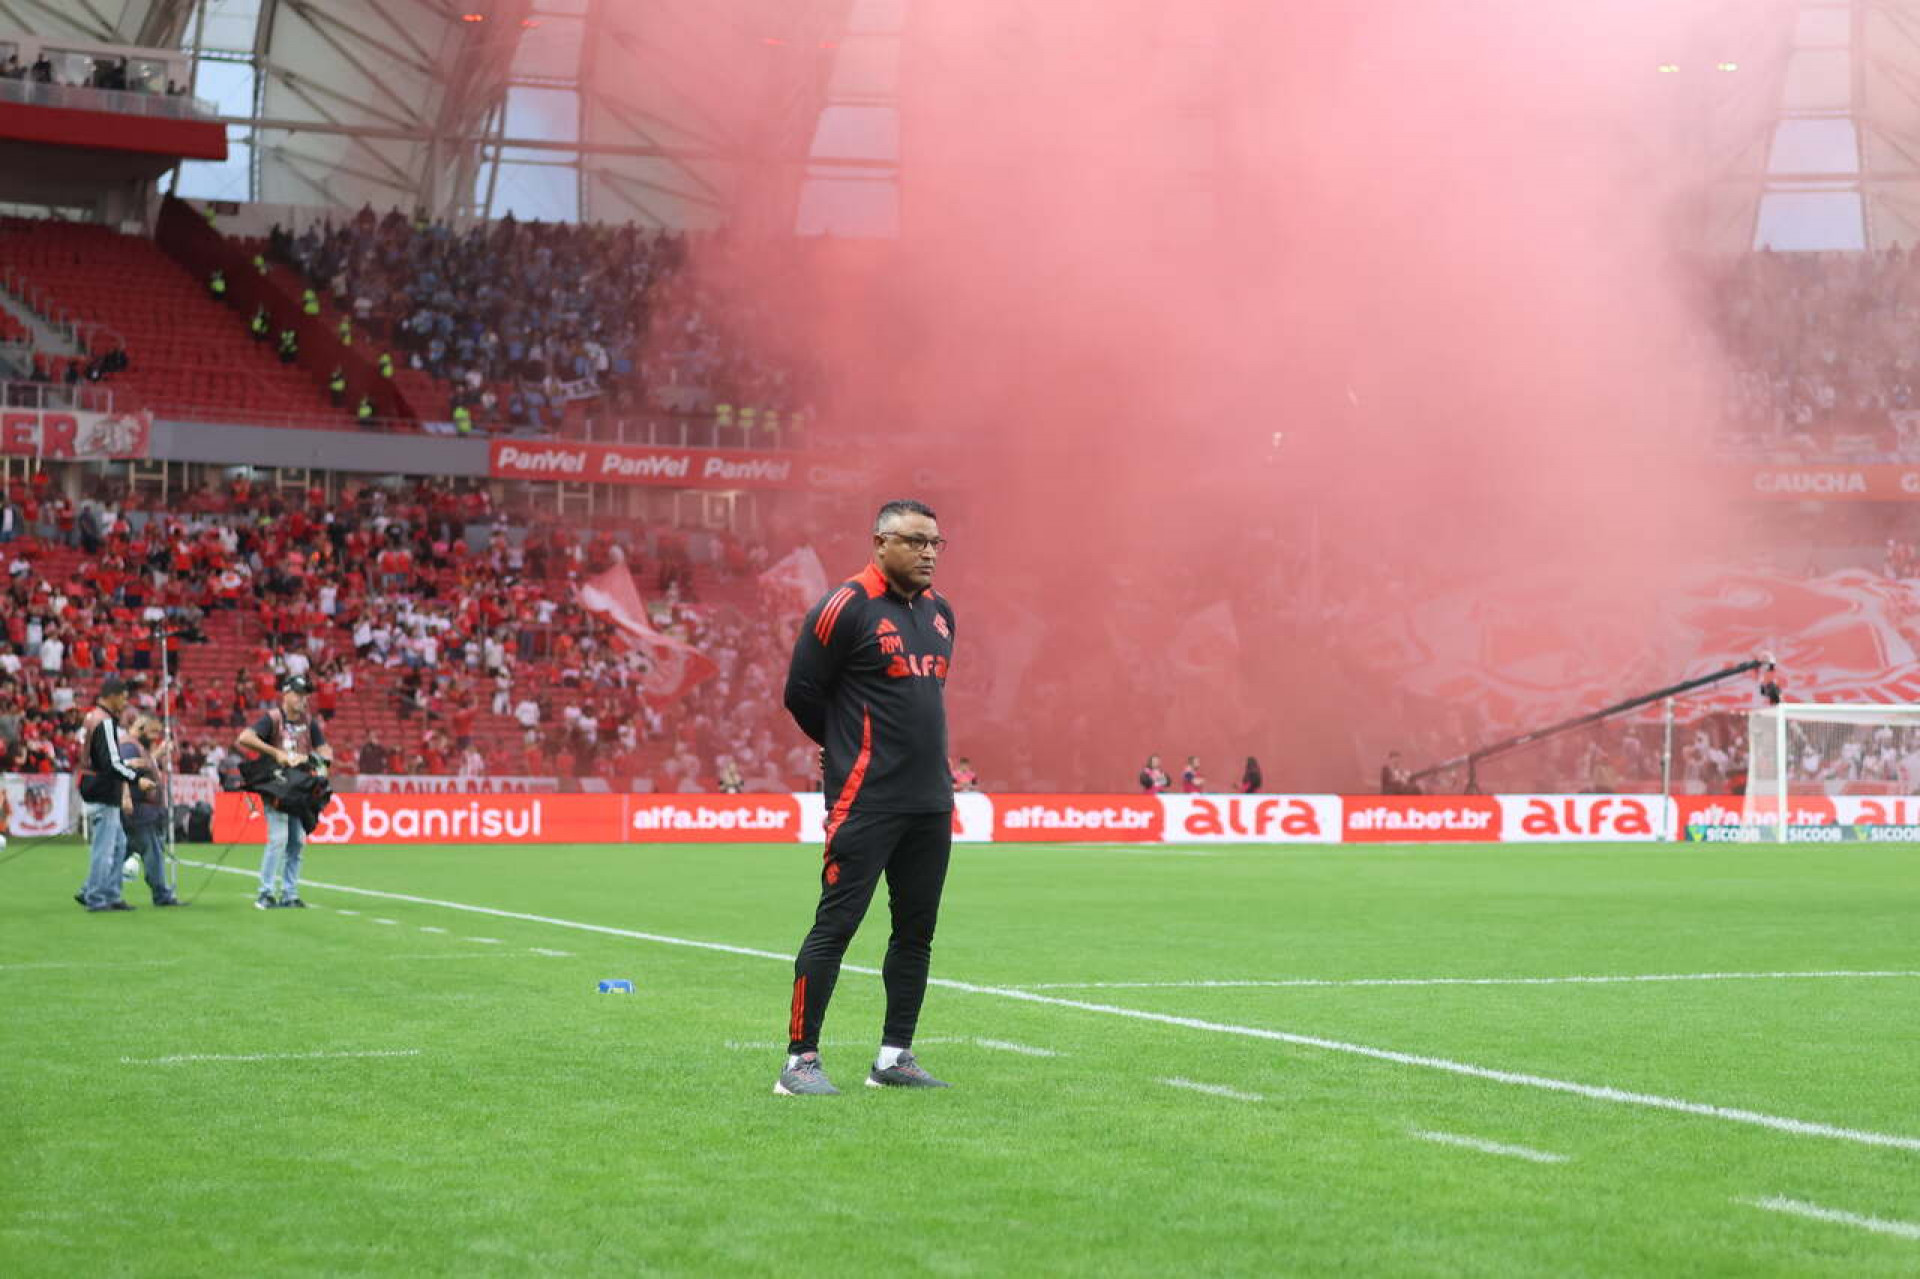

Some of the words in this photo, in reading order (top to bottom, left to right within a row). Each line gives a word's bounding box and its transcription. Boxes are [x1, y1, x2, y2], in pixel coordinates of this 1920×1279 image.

[498, 447, 586, 473] PanVel
[601, 453, 689, 477] PanVel
[704, 456, 792, 480] PanVel
[362, 799, 543, 836] banrisul
[633, 806, 791, 830] alfa.bet.br
[1004, 806, 1154, 830] alfa.bet.br
[1184, 799, 1321, 836] alfa
[1349, 806, 1493, 830] alfa.bet.br
[1521, 799, 1653, 835] alfa
